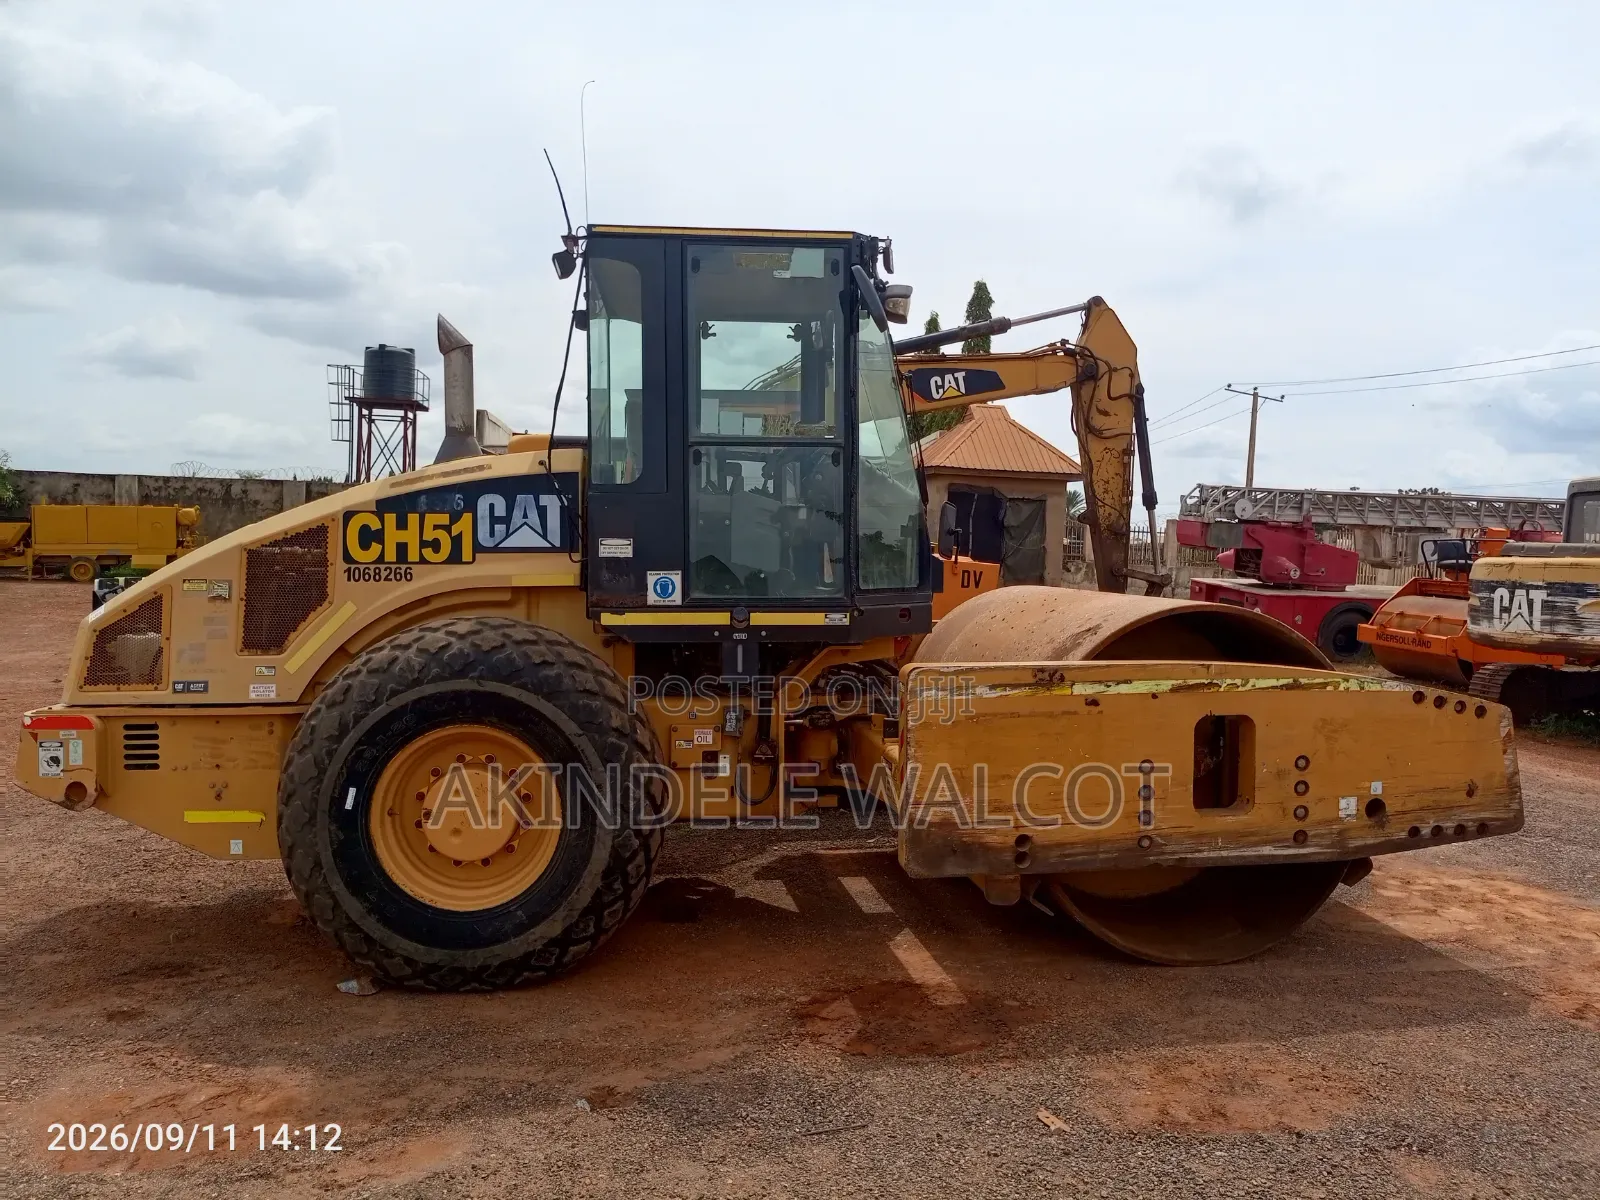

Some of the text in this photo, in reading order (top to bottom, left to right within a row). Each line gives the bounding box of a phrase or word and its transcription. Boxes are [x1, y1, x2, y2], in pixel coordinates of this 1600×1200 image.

[929, 371, 966, 400] CAT
[476, 493, 567, 548] CAT
[346, 512, 473, 563] CH51
[343, 566, 414, 582] 1068266
[960, 569, 984, 589] DV
[1492, 587, 1548, 632] CAT
[696, 735, 711, 744] OIL
